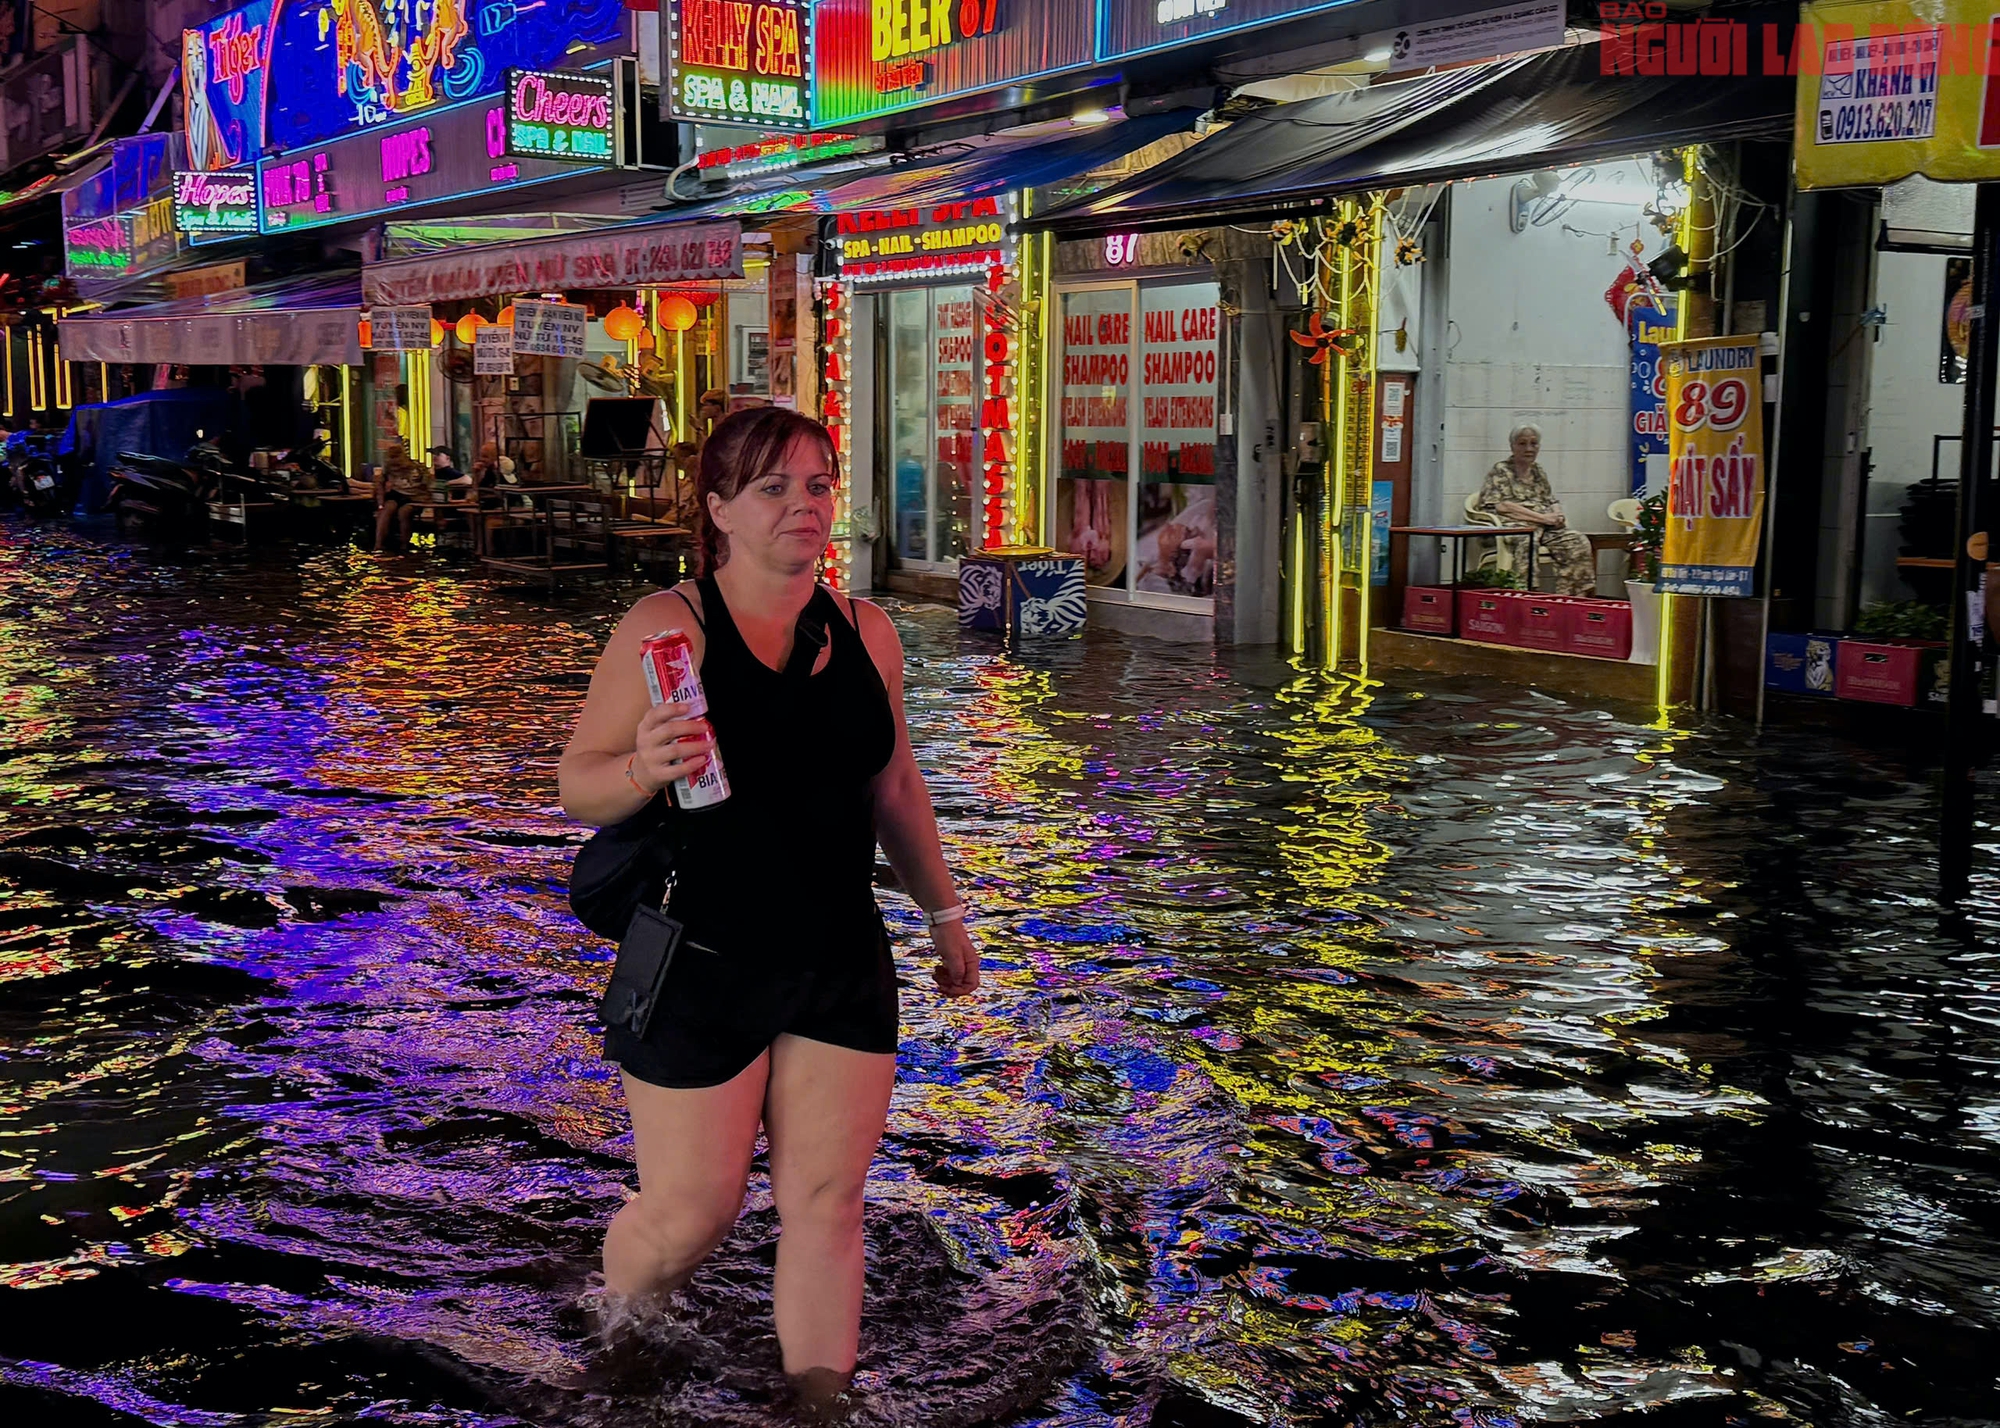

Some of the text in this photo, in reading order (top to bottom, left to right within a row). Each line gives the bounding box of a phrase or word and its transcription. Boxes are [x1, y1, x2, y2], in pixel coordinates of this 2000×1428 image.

[682, 0, 752, 71] KELLY
[755, 4, 802, 77] SPA
[871, 0, 952, 62] BEER
[208, 12, 263, 105] Tiger
[515, 75, 608, 128] Cheers
[683, 74, 727, 110] SPA
[728, 79, 750, 112] &
[552, 130, 569, 151] &
[175, 174, 255, 213] Hopes
[843, 222, 1002, 259] SPA NAIL SHAMPOO
[1064, 312, 1129, 345] NAIL CARE
[1145, 307, 1216, 343] NAIL CARE
[1064, 353, 1129, 385] SHAMPOO
[1144, 350, 1215, 385] SHAMPOO
[1687, 347, 1756, 373] LAUNDRY
[1674, 377, 1750, 432] 89
[1708, 432, 1757, 519] SẤY
[671, 686, 692, 703] BIA
[698, 772, 718, 789] BIA
